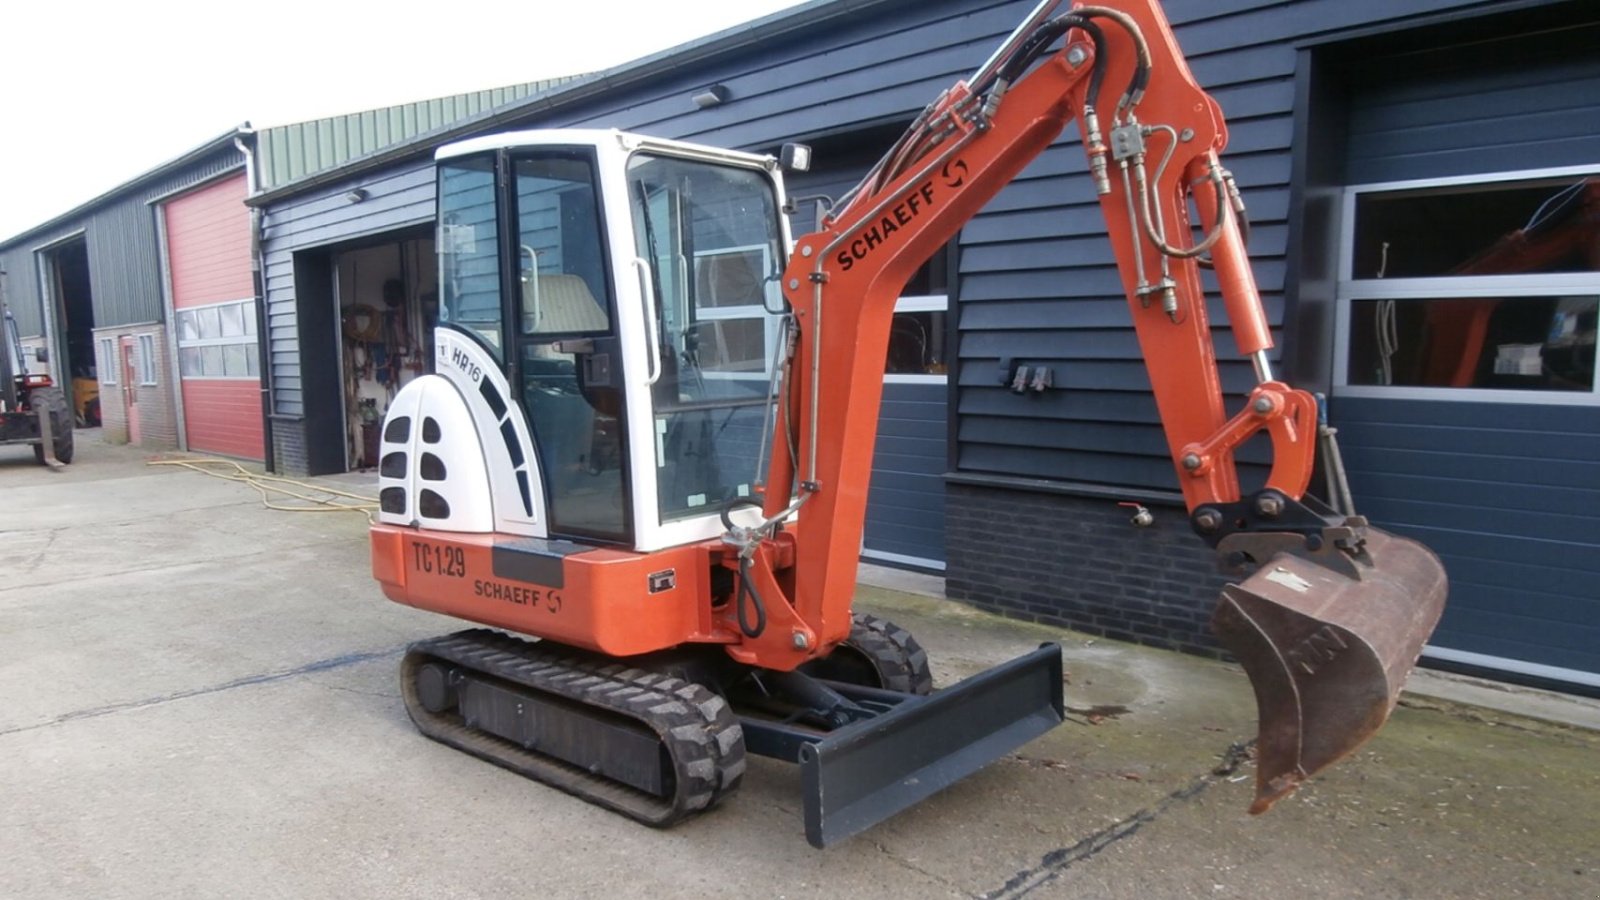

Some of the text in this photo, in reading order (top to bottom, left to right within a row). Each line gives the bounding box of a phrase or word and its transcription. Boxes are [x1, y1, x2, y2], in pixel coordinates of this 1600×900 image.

[837, 181, 934, 271] SCHAEFF
[452, 347, 482, 382] HR16
[474, 579, 540, 606] SCHAEFF
